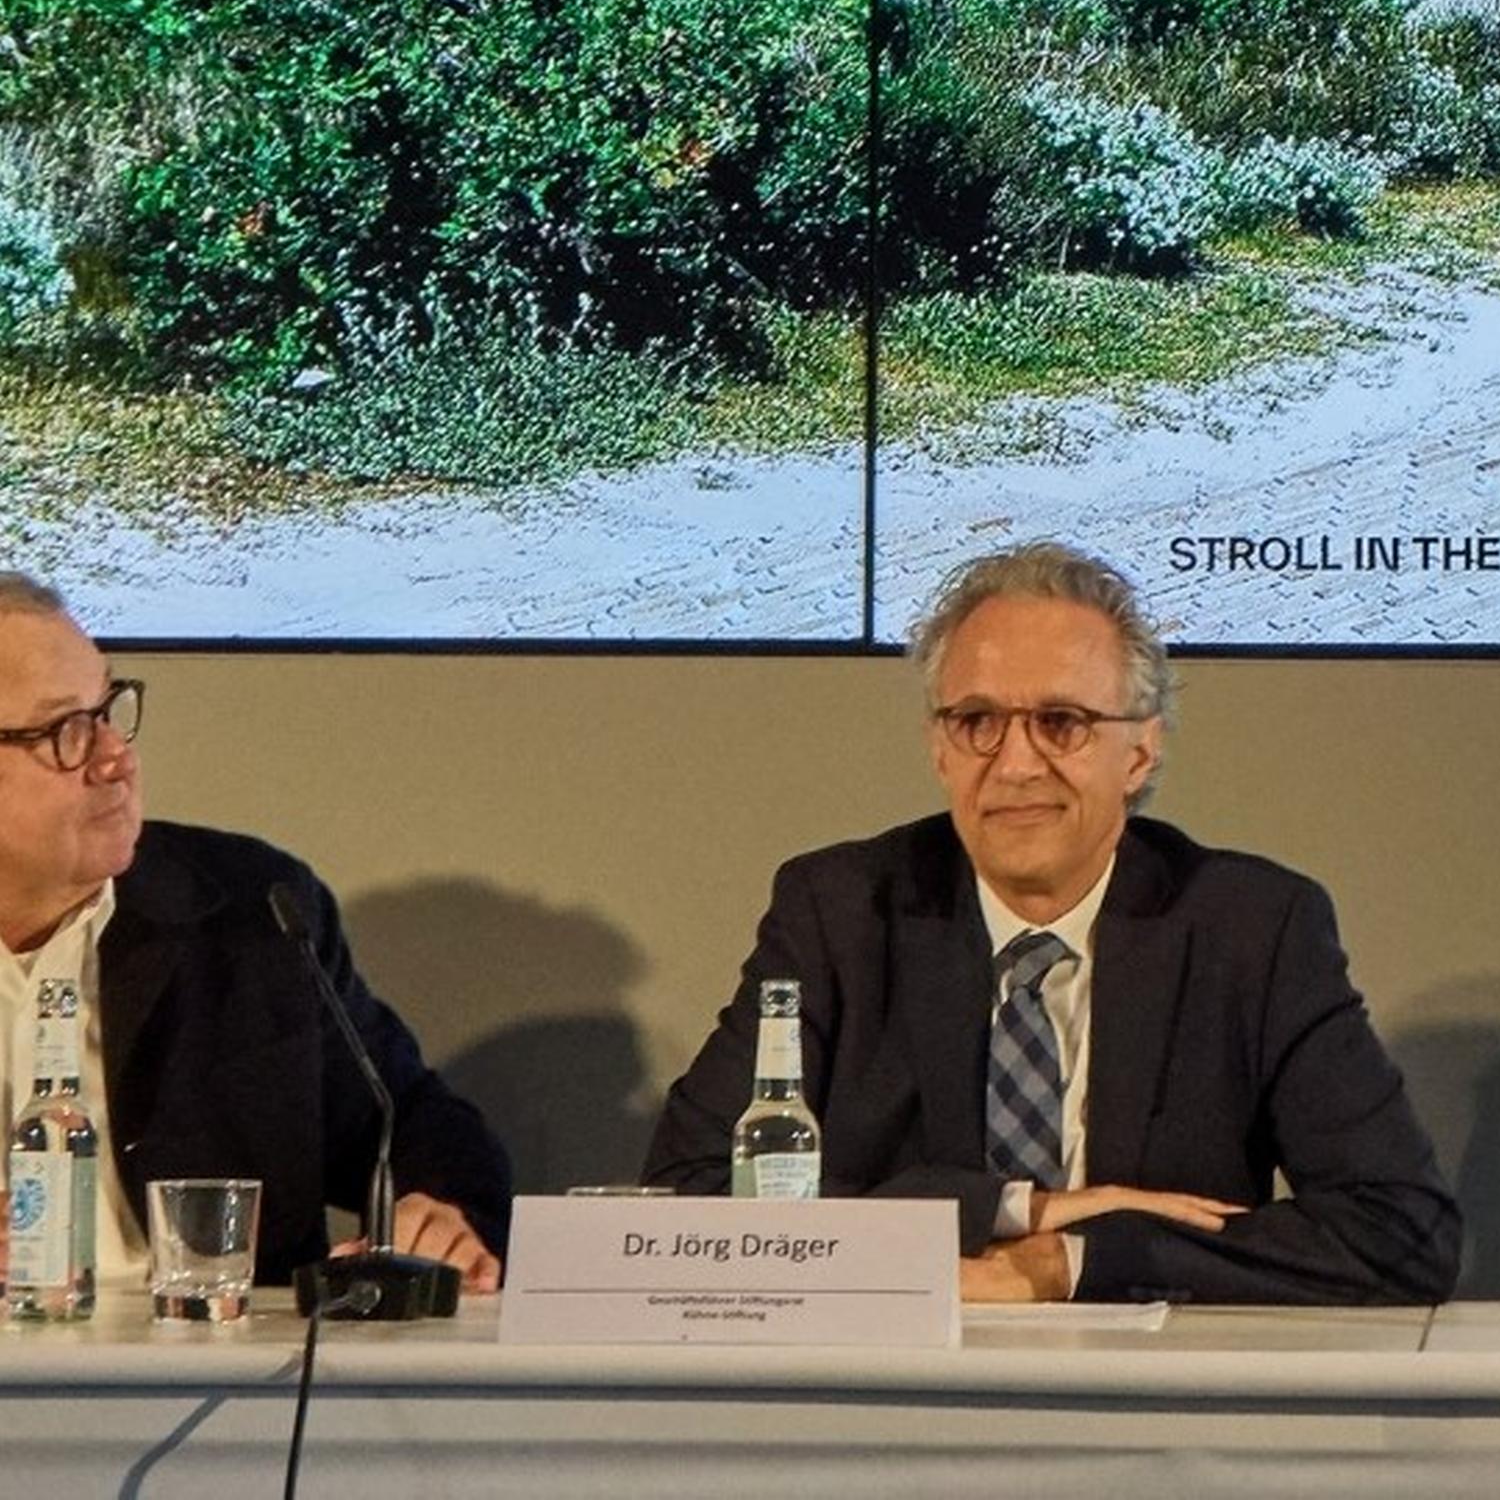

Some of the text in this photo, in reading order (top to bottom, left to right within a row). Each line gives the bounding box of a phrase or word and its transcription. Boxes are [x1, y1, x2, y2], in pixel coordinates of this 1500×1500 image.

[1169, 535, 1342, 572] STROLL
[1354, 536, 1400, 571] IN
[1412, 536, 1500, 571] THE
[623, 1233, 839, 1263] Dr. Jörg Dräger
